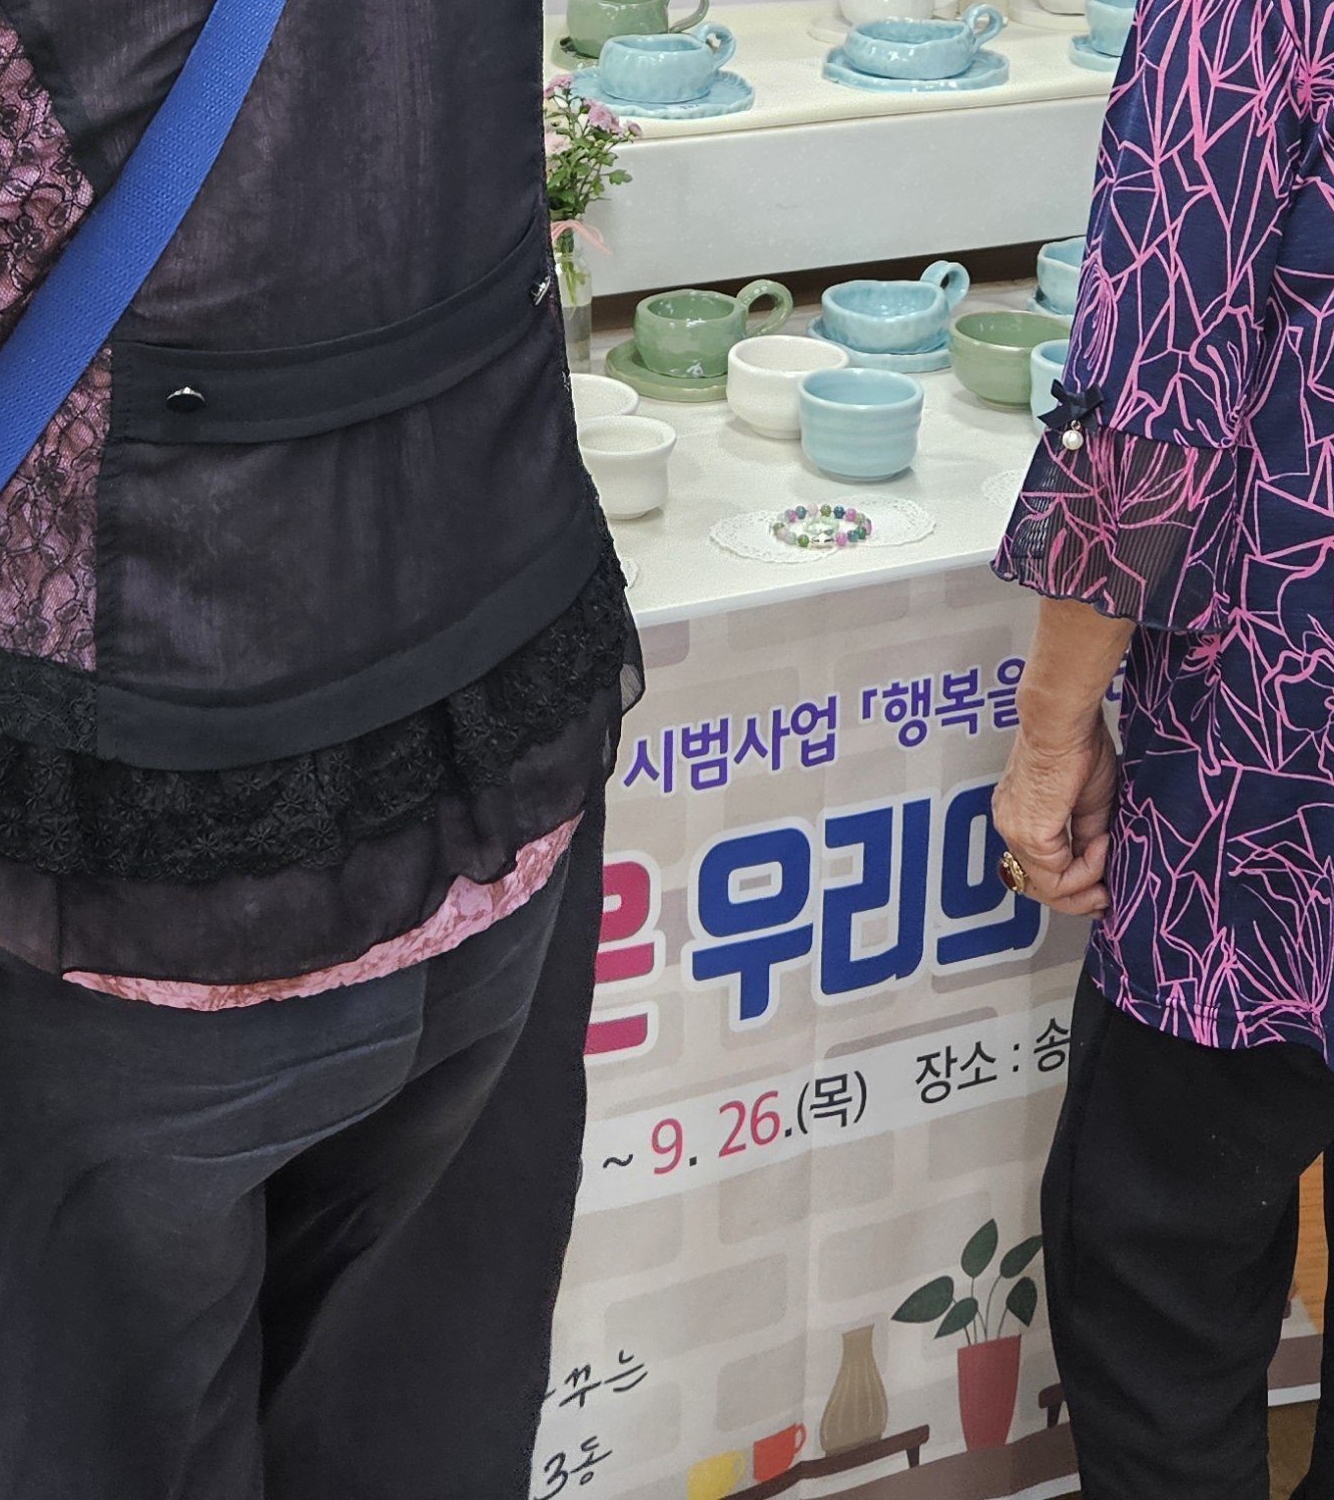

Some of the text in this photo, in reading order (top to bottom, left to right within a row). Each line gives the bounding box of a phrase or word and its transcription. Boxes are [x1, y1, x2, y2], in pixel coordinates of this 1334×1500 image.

[623, 696, 838, 794] 시범사업
[691, 783, 1042, 1022] 우리의
[545, 1349, 648, 1409] 꾸는
